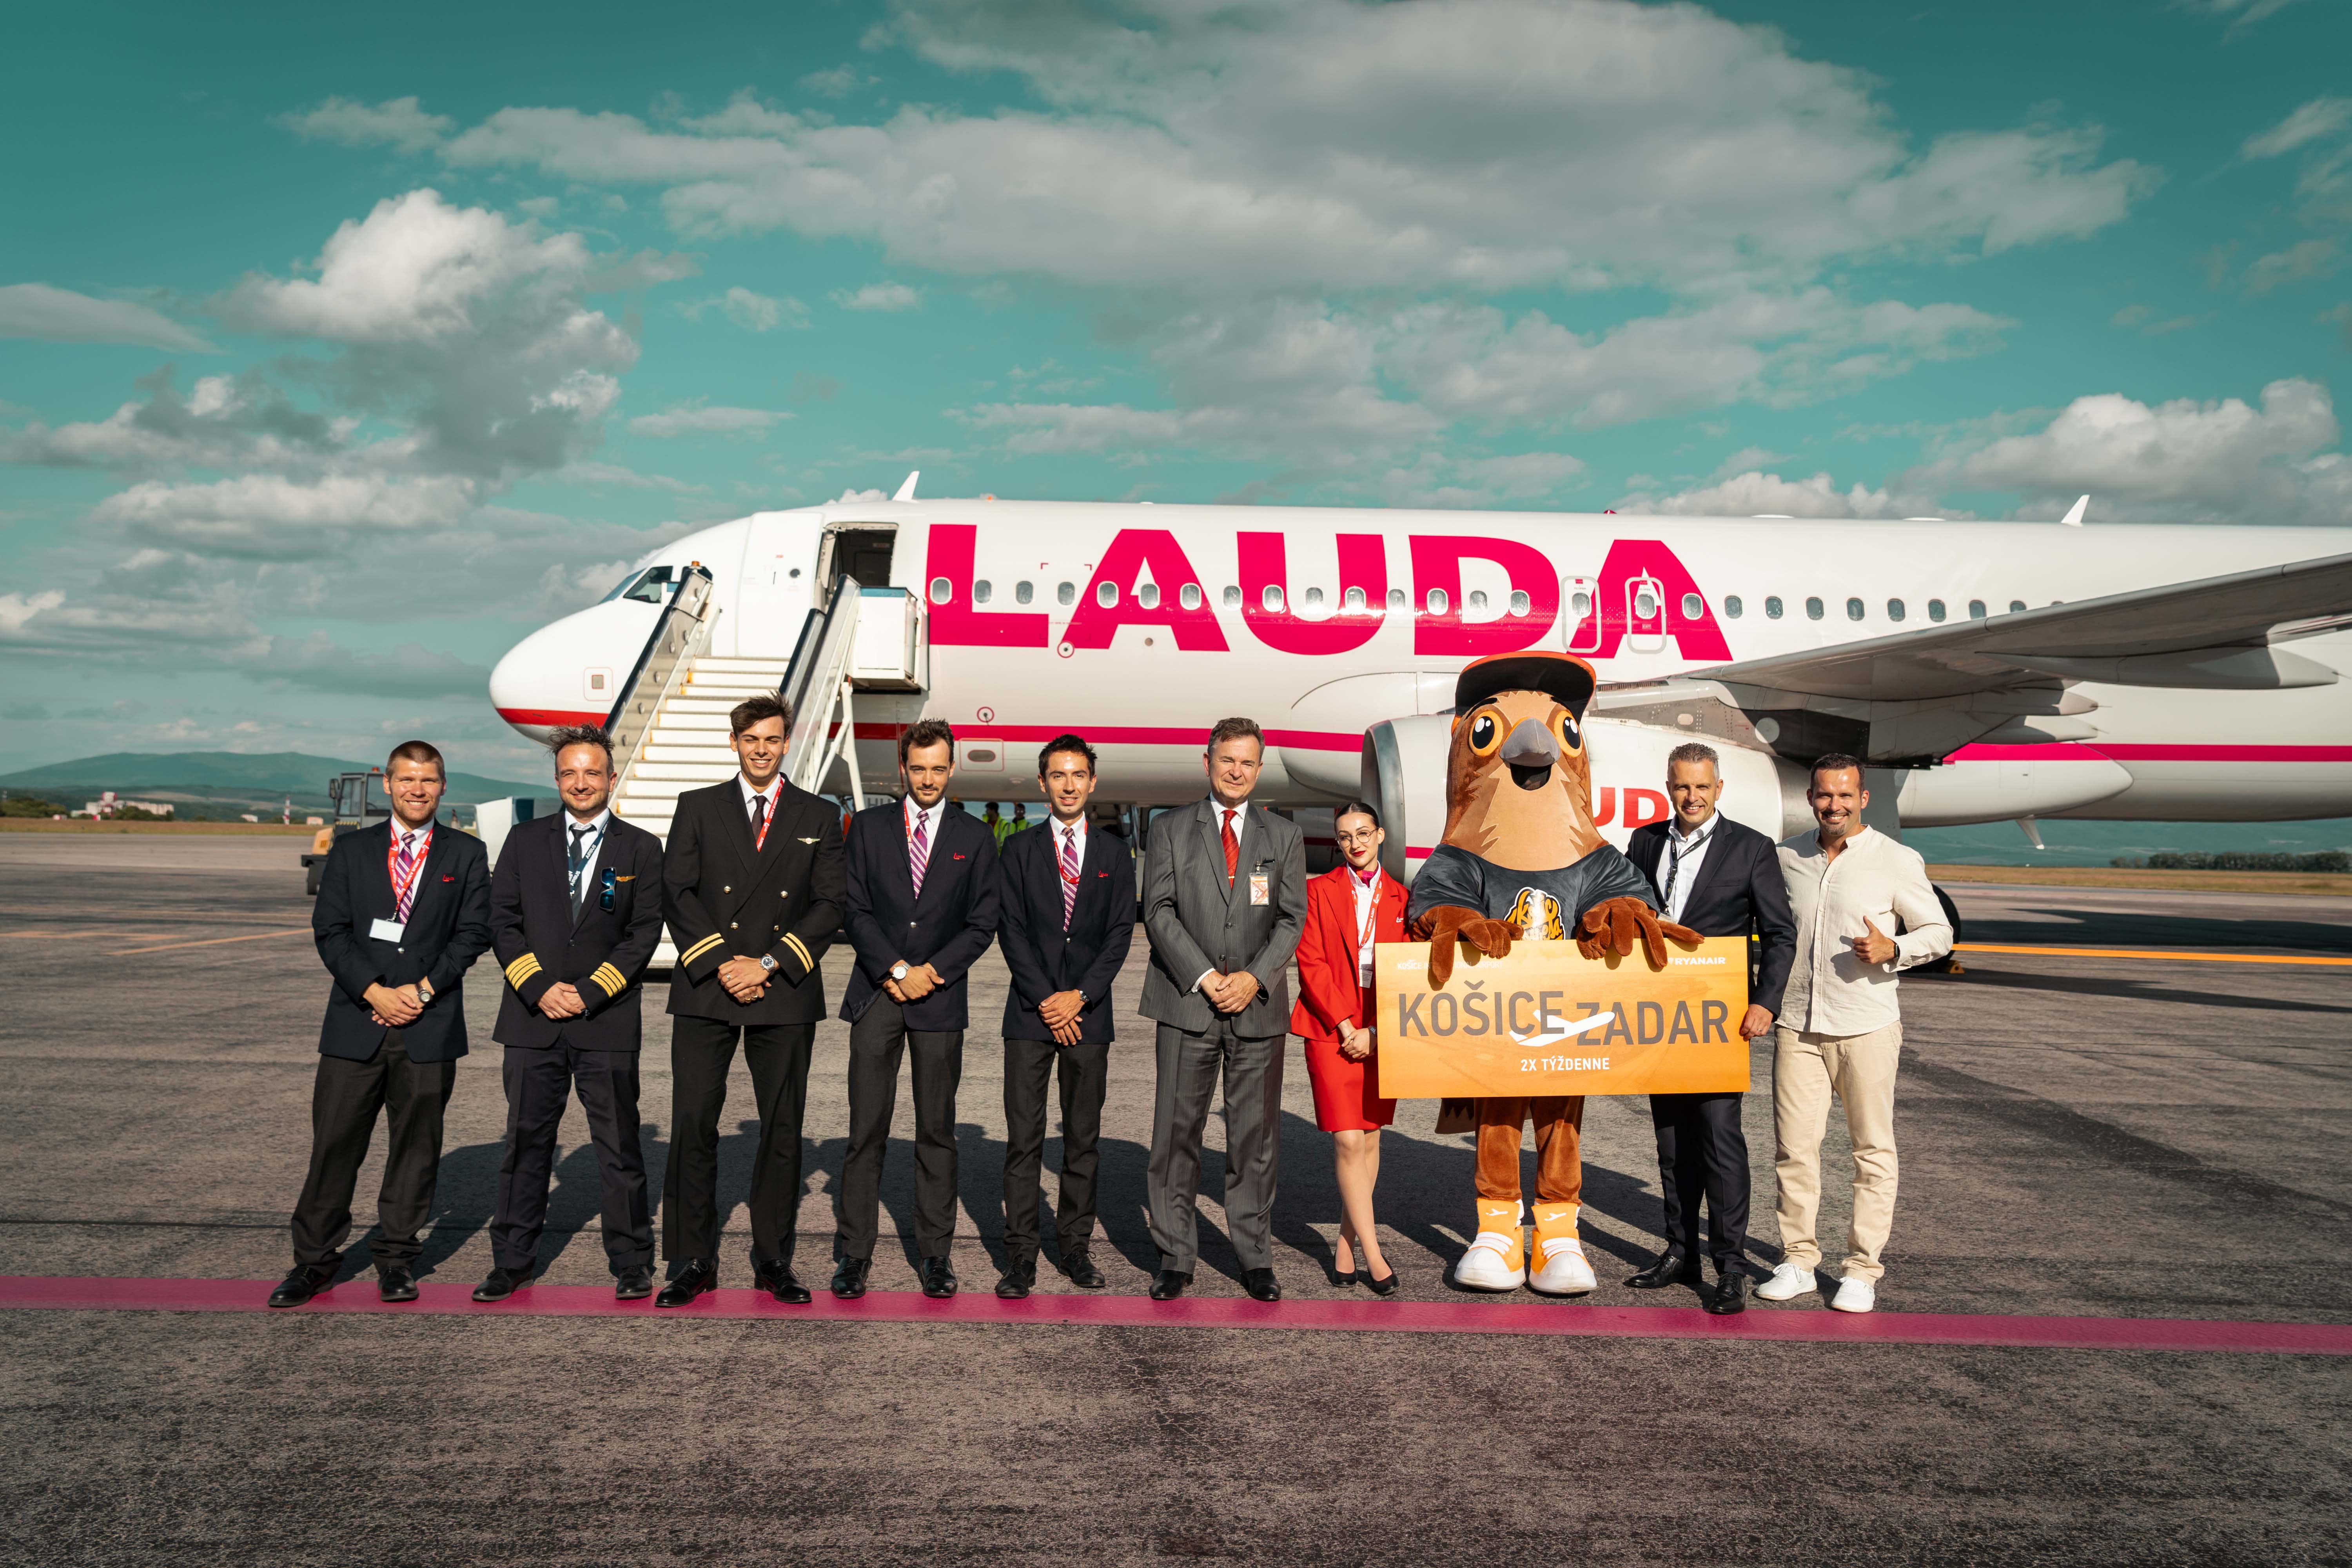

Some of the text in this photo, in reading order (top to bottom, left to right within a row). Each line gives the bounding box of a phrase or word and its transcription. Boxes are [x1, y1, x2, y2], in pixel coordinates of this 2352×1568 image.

[926, 524, 1733, 661] LAUDA
[585, 844, 596, 859] AIRBUS
[570, 871, 581, 886] AIRBUS
[1397, 959, 1422, 970] KOŠICE
[1477, 960, 1503, 969] AIRPORT
[1675, 956, 1726, 965] RYANAIR
[1399, 980, 1729, 1046] KOŠICE ZADAR
[1521, 1055, 1610, 1071] 2X TÝŽDENNE
